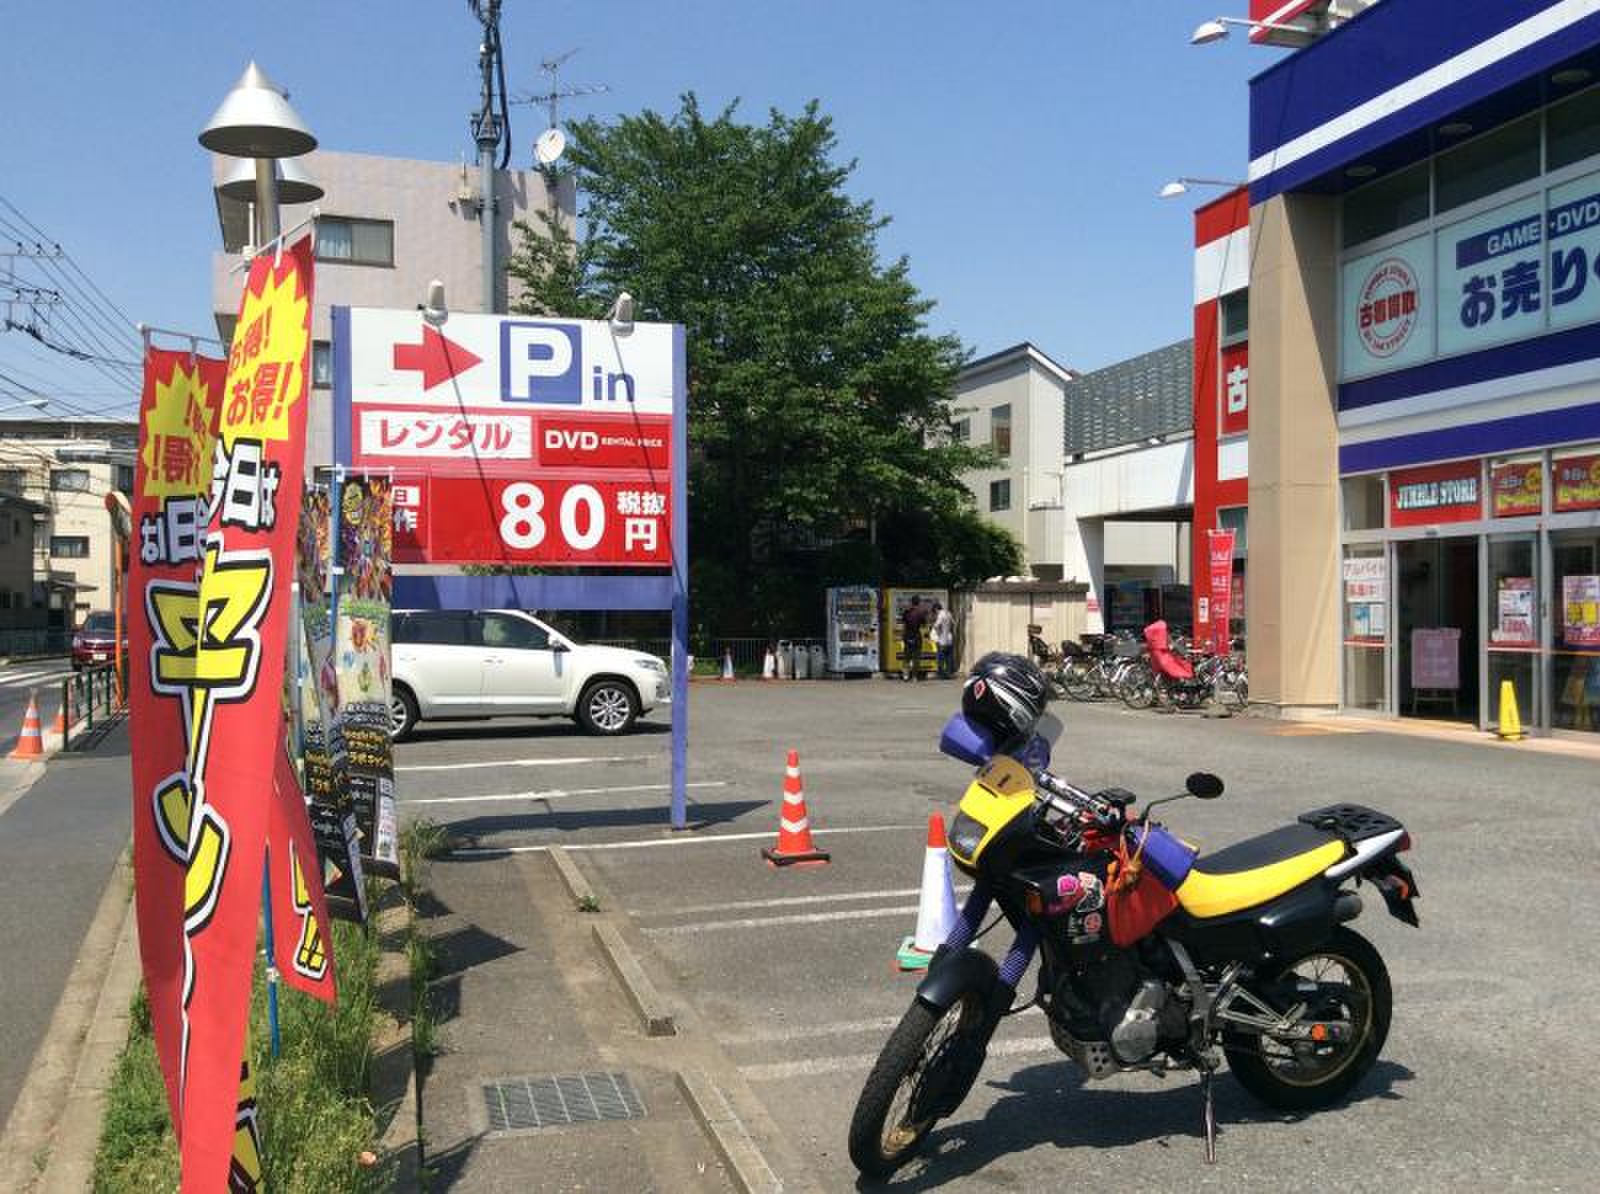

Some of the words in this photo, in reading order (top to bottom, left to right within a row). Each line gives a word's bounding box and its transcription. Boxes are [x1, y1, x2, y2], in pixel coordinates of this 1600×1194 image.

[1461, 247, 1600, 328] お売り
[510, 326, 573, 399] P
[593, 365, 635, 401] in
[380, 419, 513, 450] レンタル
[544, 430, 599, 450] DVD
[501, 482, 605, 550] 80
[617, 490, 666, 515] 税抜
[624, 518, 657, 551] 円
